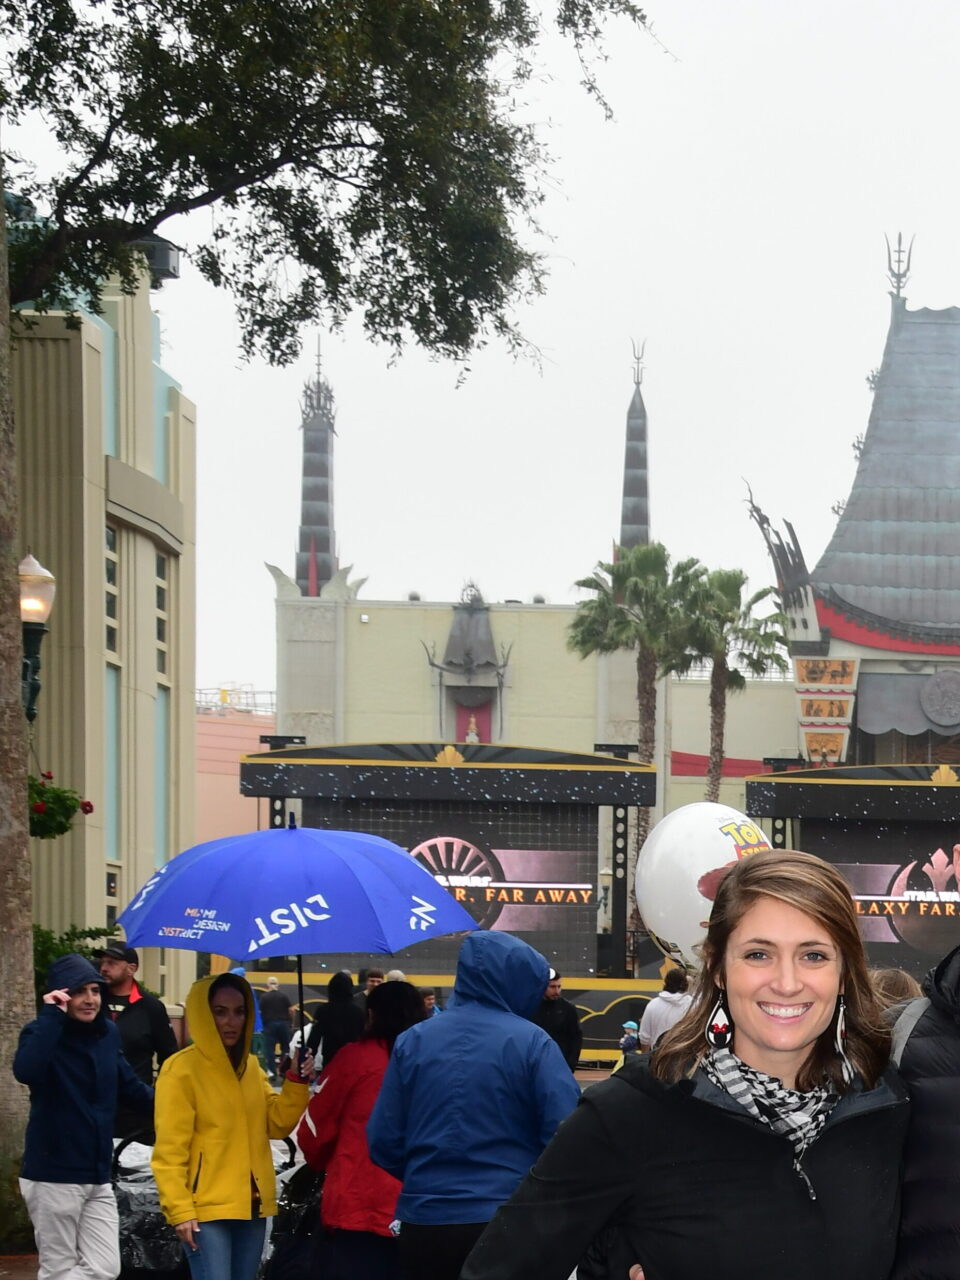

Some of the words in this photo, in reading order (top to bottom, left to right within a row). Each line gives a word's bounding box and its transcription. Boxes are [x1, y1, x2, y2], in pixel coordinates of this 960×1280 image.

[485, 888, 524, 902] FAR
[535, 890, 593, 903] AWAY
[184, 907, 216, 919] MIAMI
[855, 901, 909, 915] LAXY
[193, 919, 231, 932] DESIGN
[248, 894, 331, 953] DIST
[158, 926, 204, 939] DISTRICT
